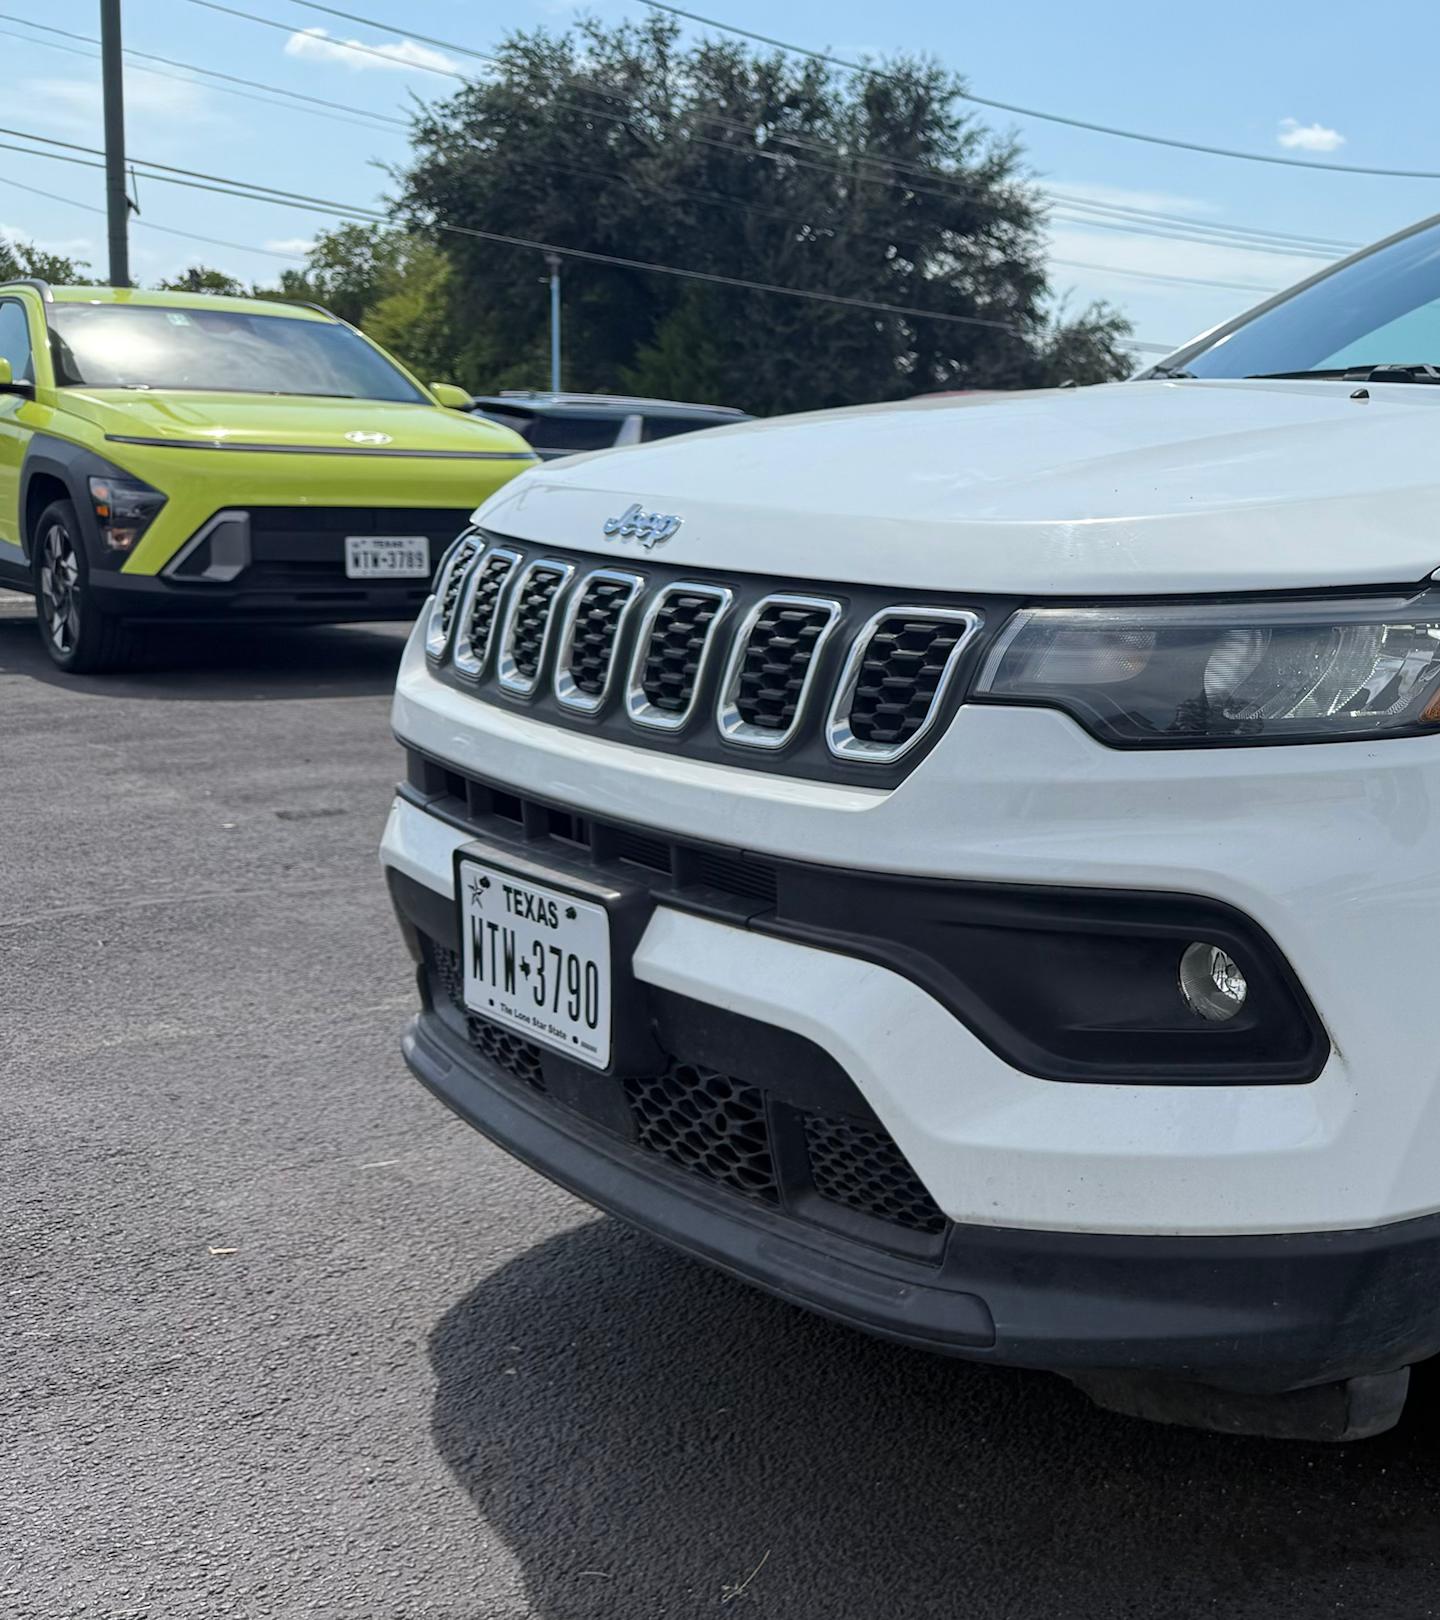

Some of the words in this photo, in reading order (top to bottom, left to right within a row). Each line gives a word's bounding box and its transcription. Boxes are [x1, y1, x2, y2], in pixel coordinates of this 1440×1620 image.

[603, 503, 683, 549] Jeep
[503, 885, 559, 930] TEXAS
[501, 1002, 513, 1016] The
[514, 1008, 531, 1024] Lone
[532, 1017, 547, 1030] Star
[548, 1024, 567, 1040] State
